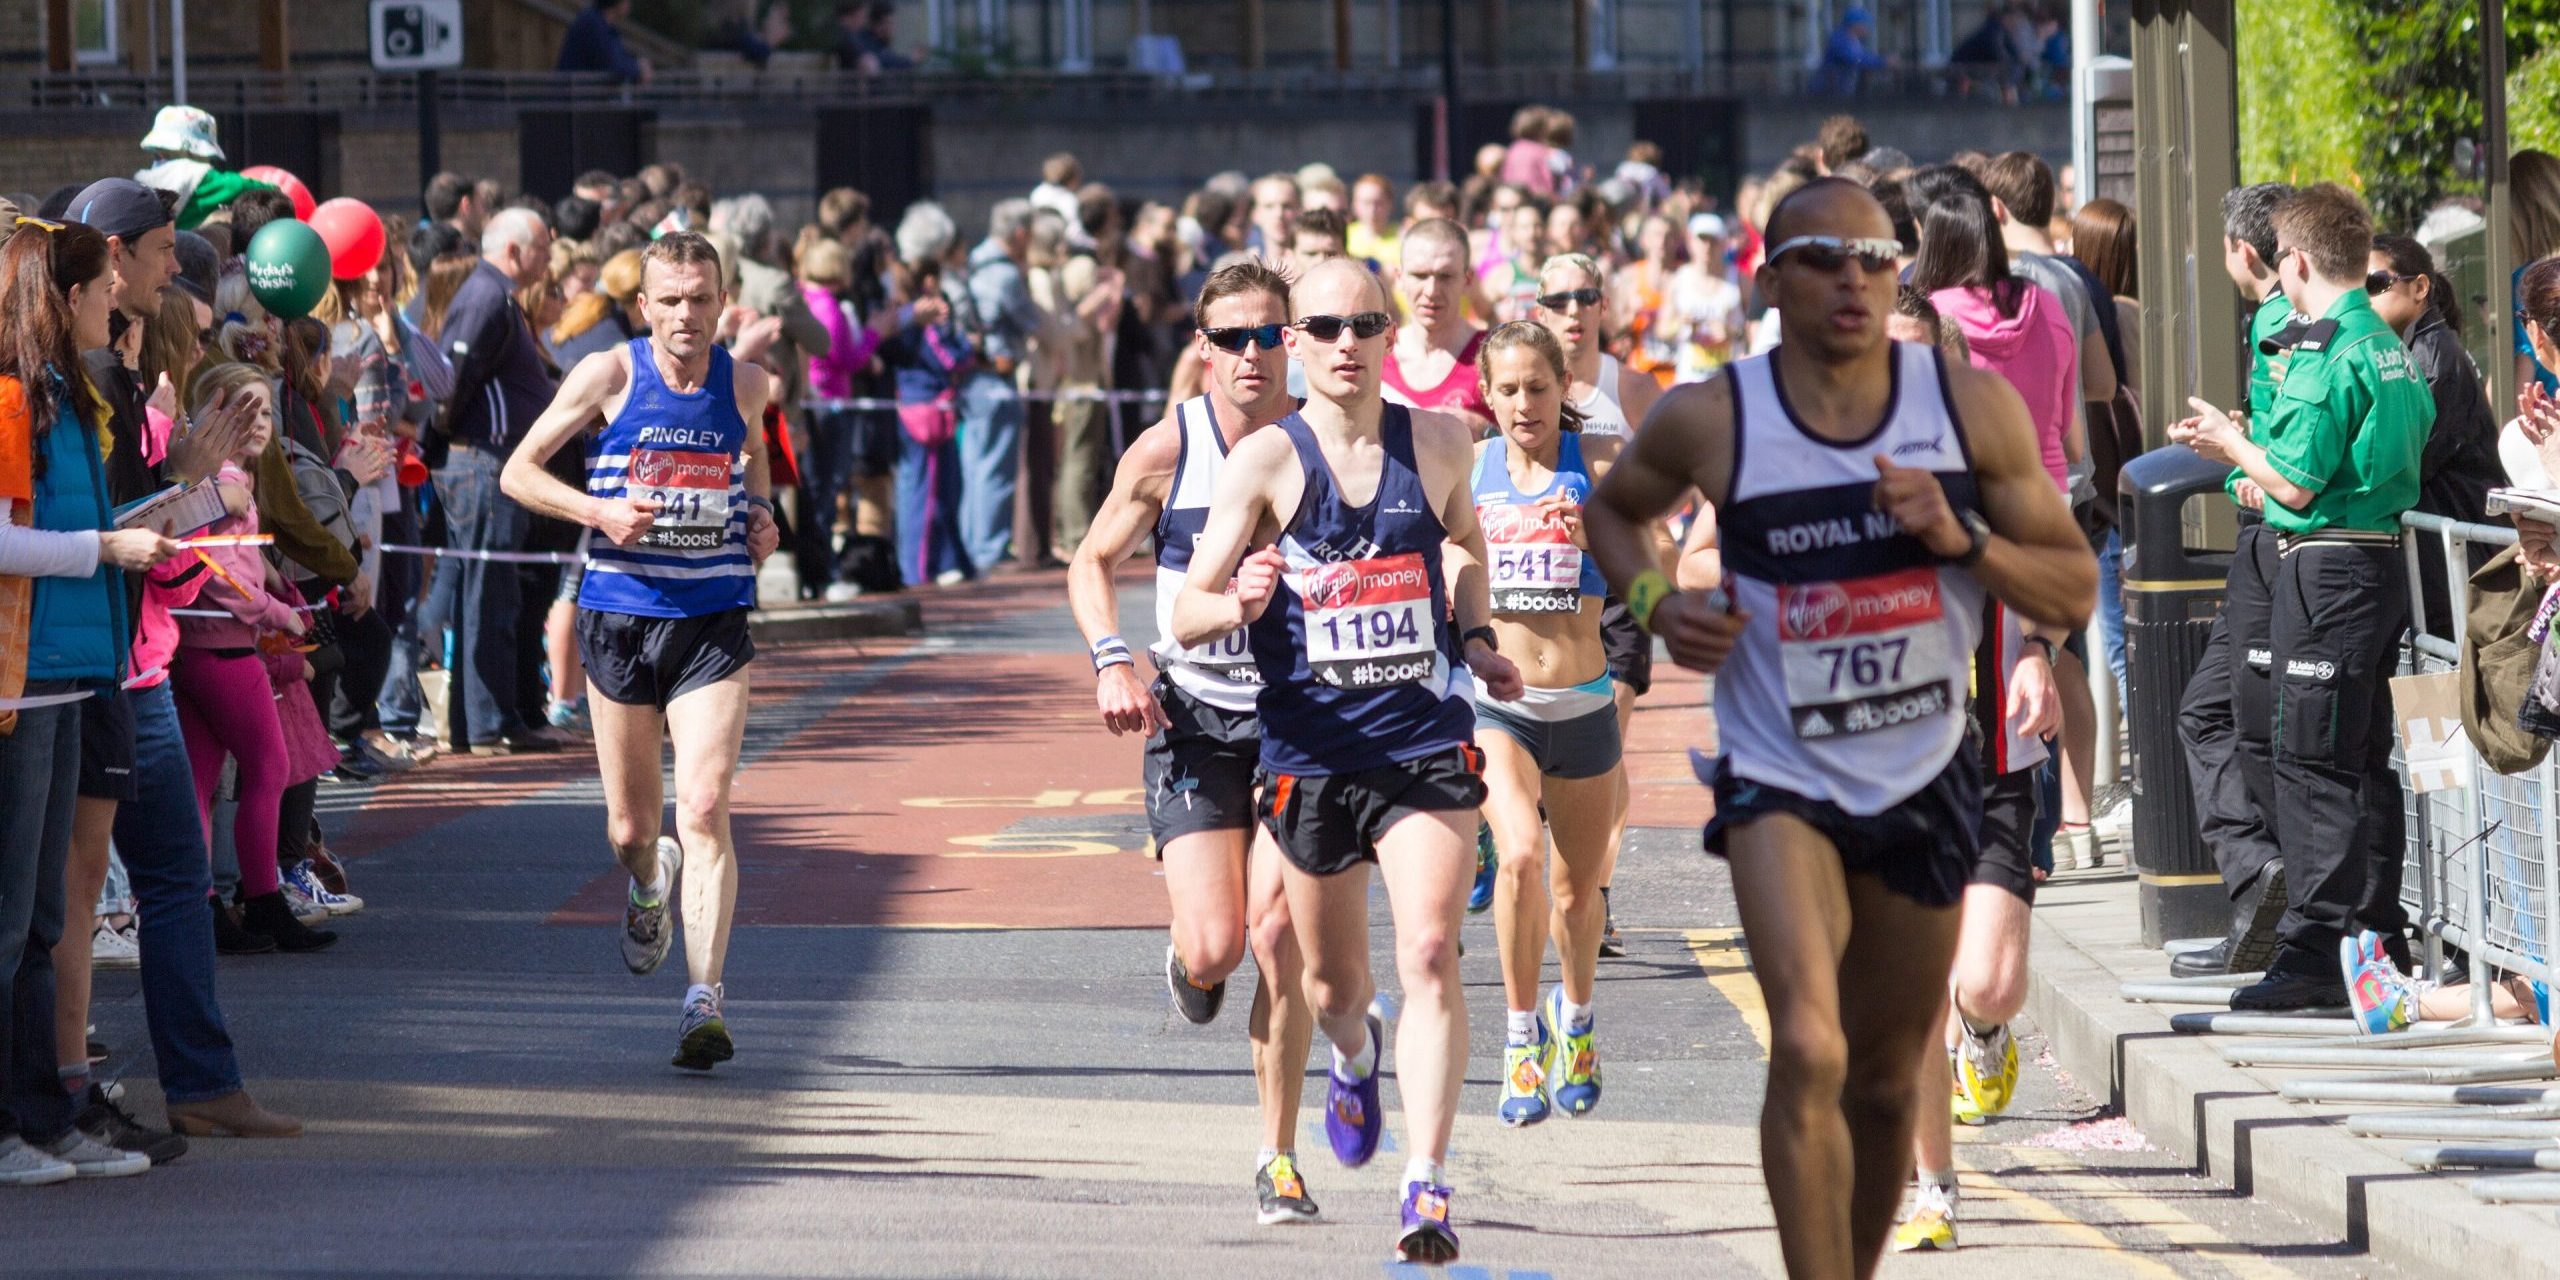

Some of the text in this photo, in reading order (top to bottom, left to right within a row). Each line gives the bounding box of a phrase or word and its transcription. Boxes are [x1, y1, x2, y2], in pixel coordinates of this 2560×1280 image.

[638, 426, 724, 448] BINGLEY
[636, 452, 725, 484] Virgin money
[657, 531, 718, 547] #boost
[1766, 517, 1862, 555] ROYAL
[1498, 548, 1552, 582] 541
[1310, 565, 1423, 607] Virgin money
[1505, 592, 1577, 612] #boost
[1322, 606, 1420, 652] 1194
[1789, 584, 1935, 638] Virgin money
[1352, 657, 1432, 685] #boost
[1818, 636, 1911, 693] 767
[1845, 685, 1945, 733] #boost
